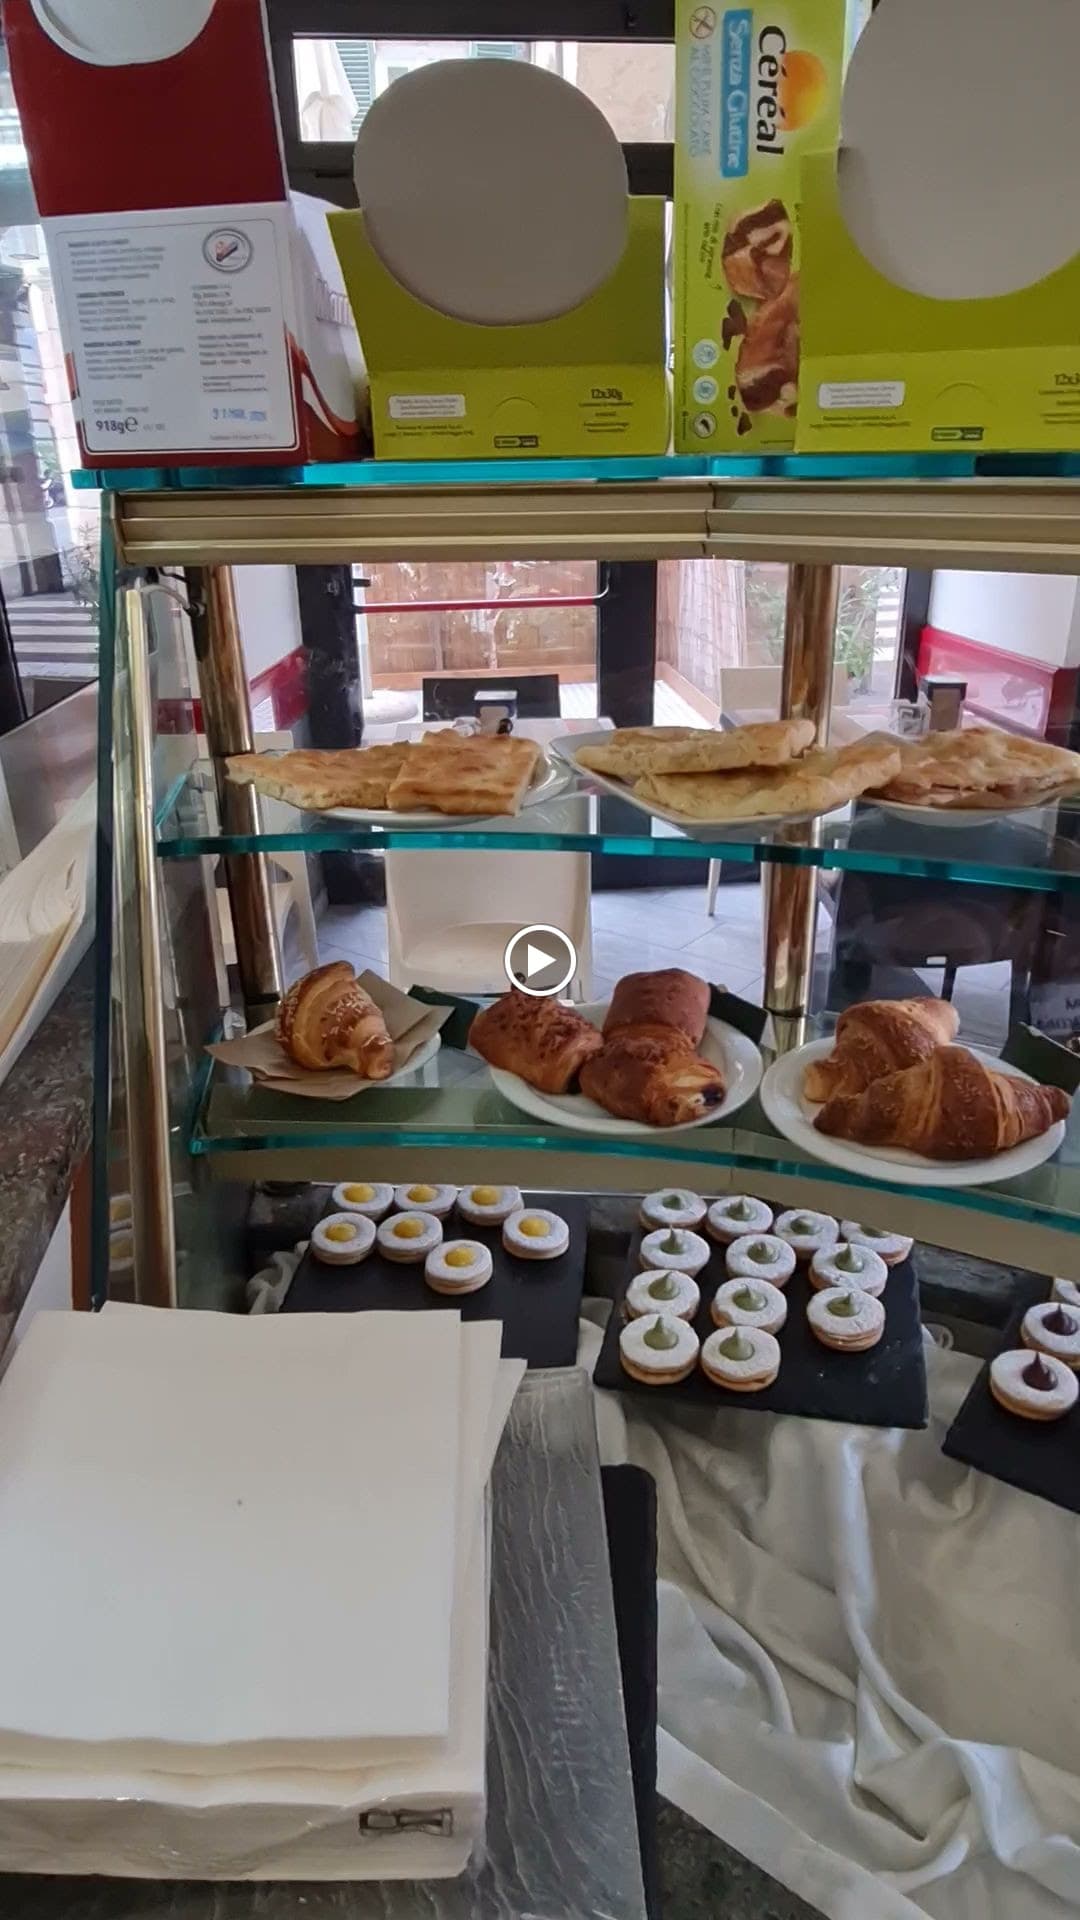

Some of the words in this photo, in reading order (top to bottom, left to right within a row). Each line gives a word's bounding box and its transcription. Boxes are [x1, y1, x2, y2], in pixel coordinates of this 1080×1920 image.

[728, 18, 748, 86] Senza
[756, 25, 787, 155] Céréal
[727, 89, 748, 169] Glutine
